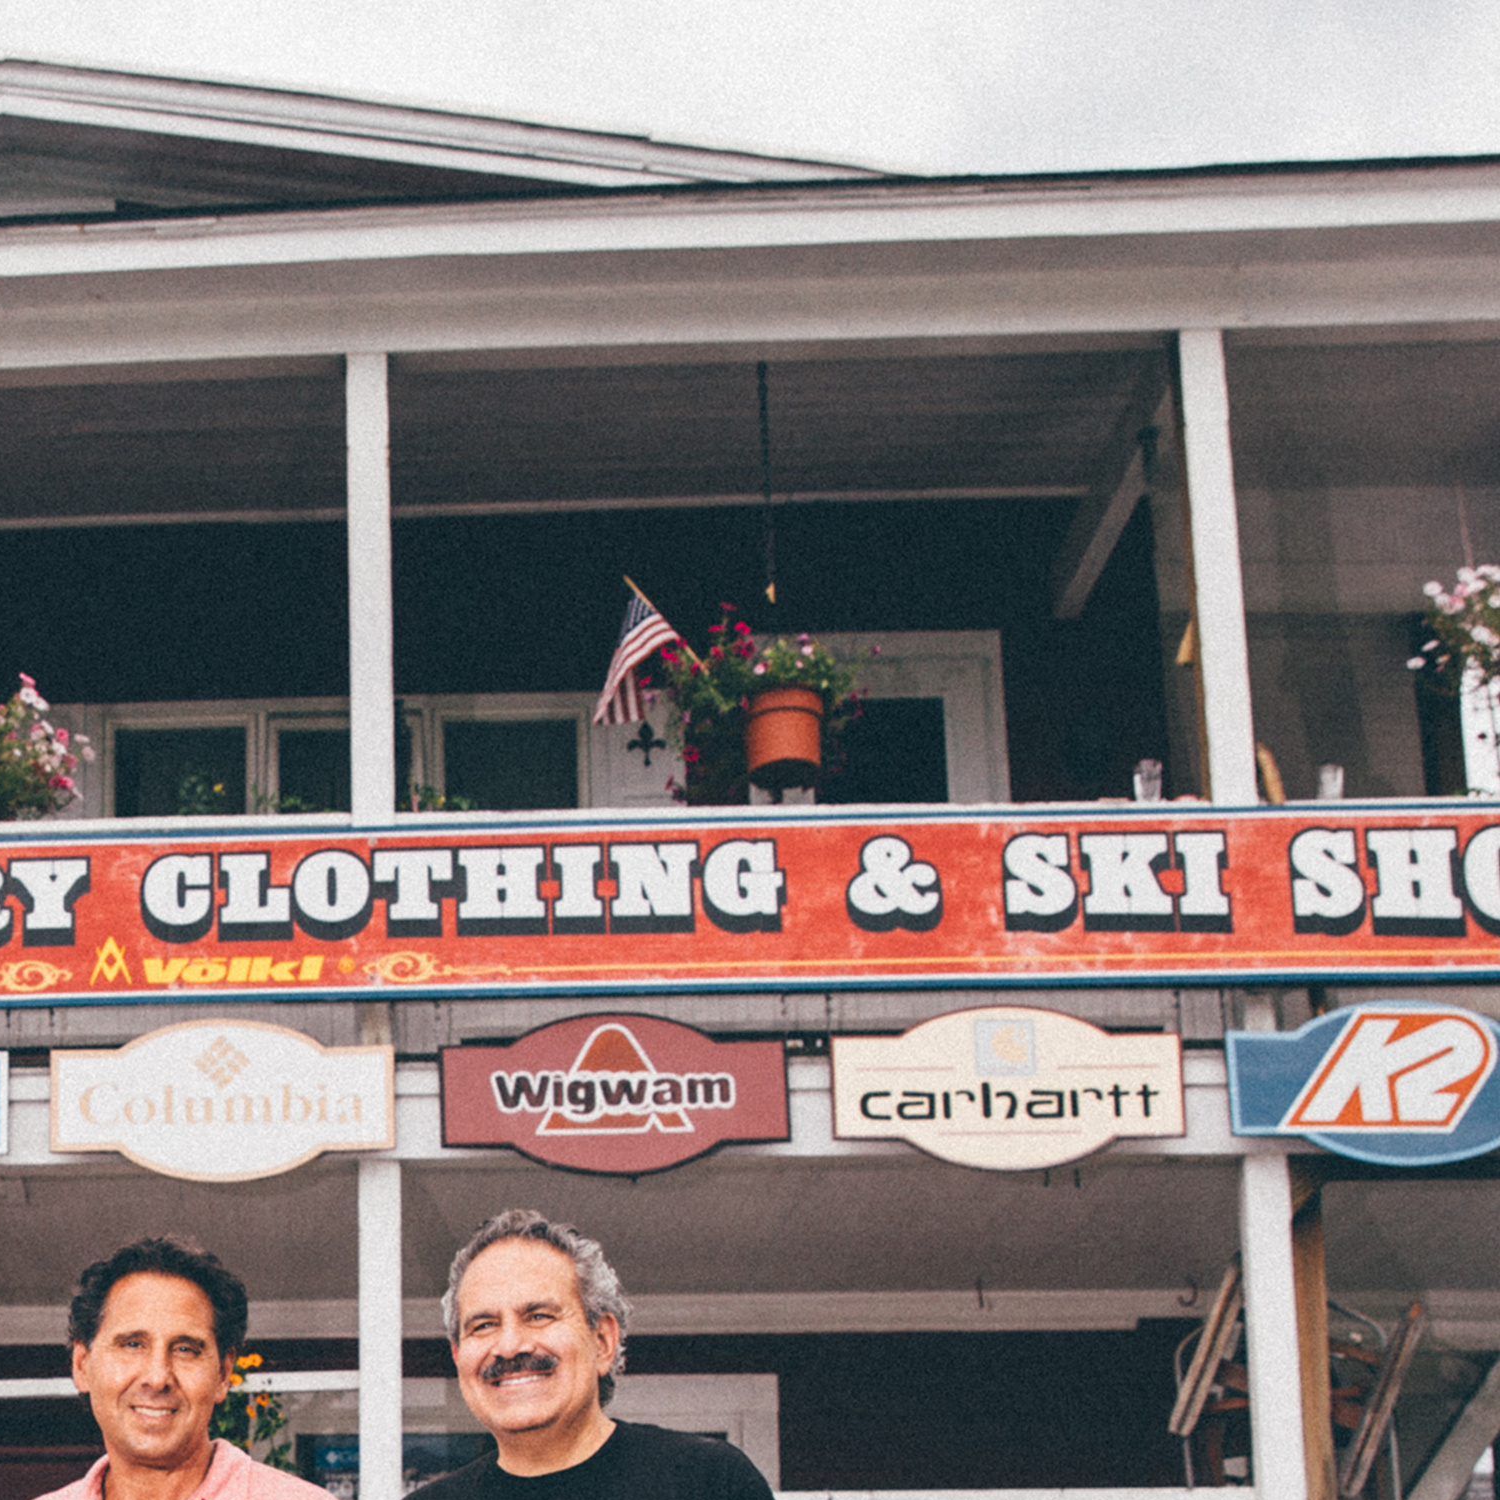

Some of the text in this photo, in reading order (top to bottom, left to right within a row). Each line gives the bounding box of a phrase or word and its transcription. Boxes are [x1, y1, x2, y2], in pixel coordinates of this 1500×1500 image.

[141, 838, 786, 942] CLOTHING
[845, 834, 943, 933] &
[1003, 829, 1233, 933] SKI
[491, 1070, 737, 1121] Wigwam
[1300, 1016, 1493, 1123] K2
[77, 1074, 364, 1127] Columbia
[859, 1081, 1160, 1120] carhartt
